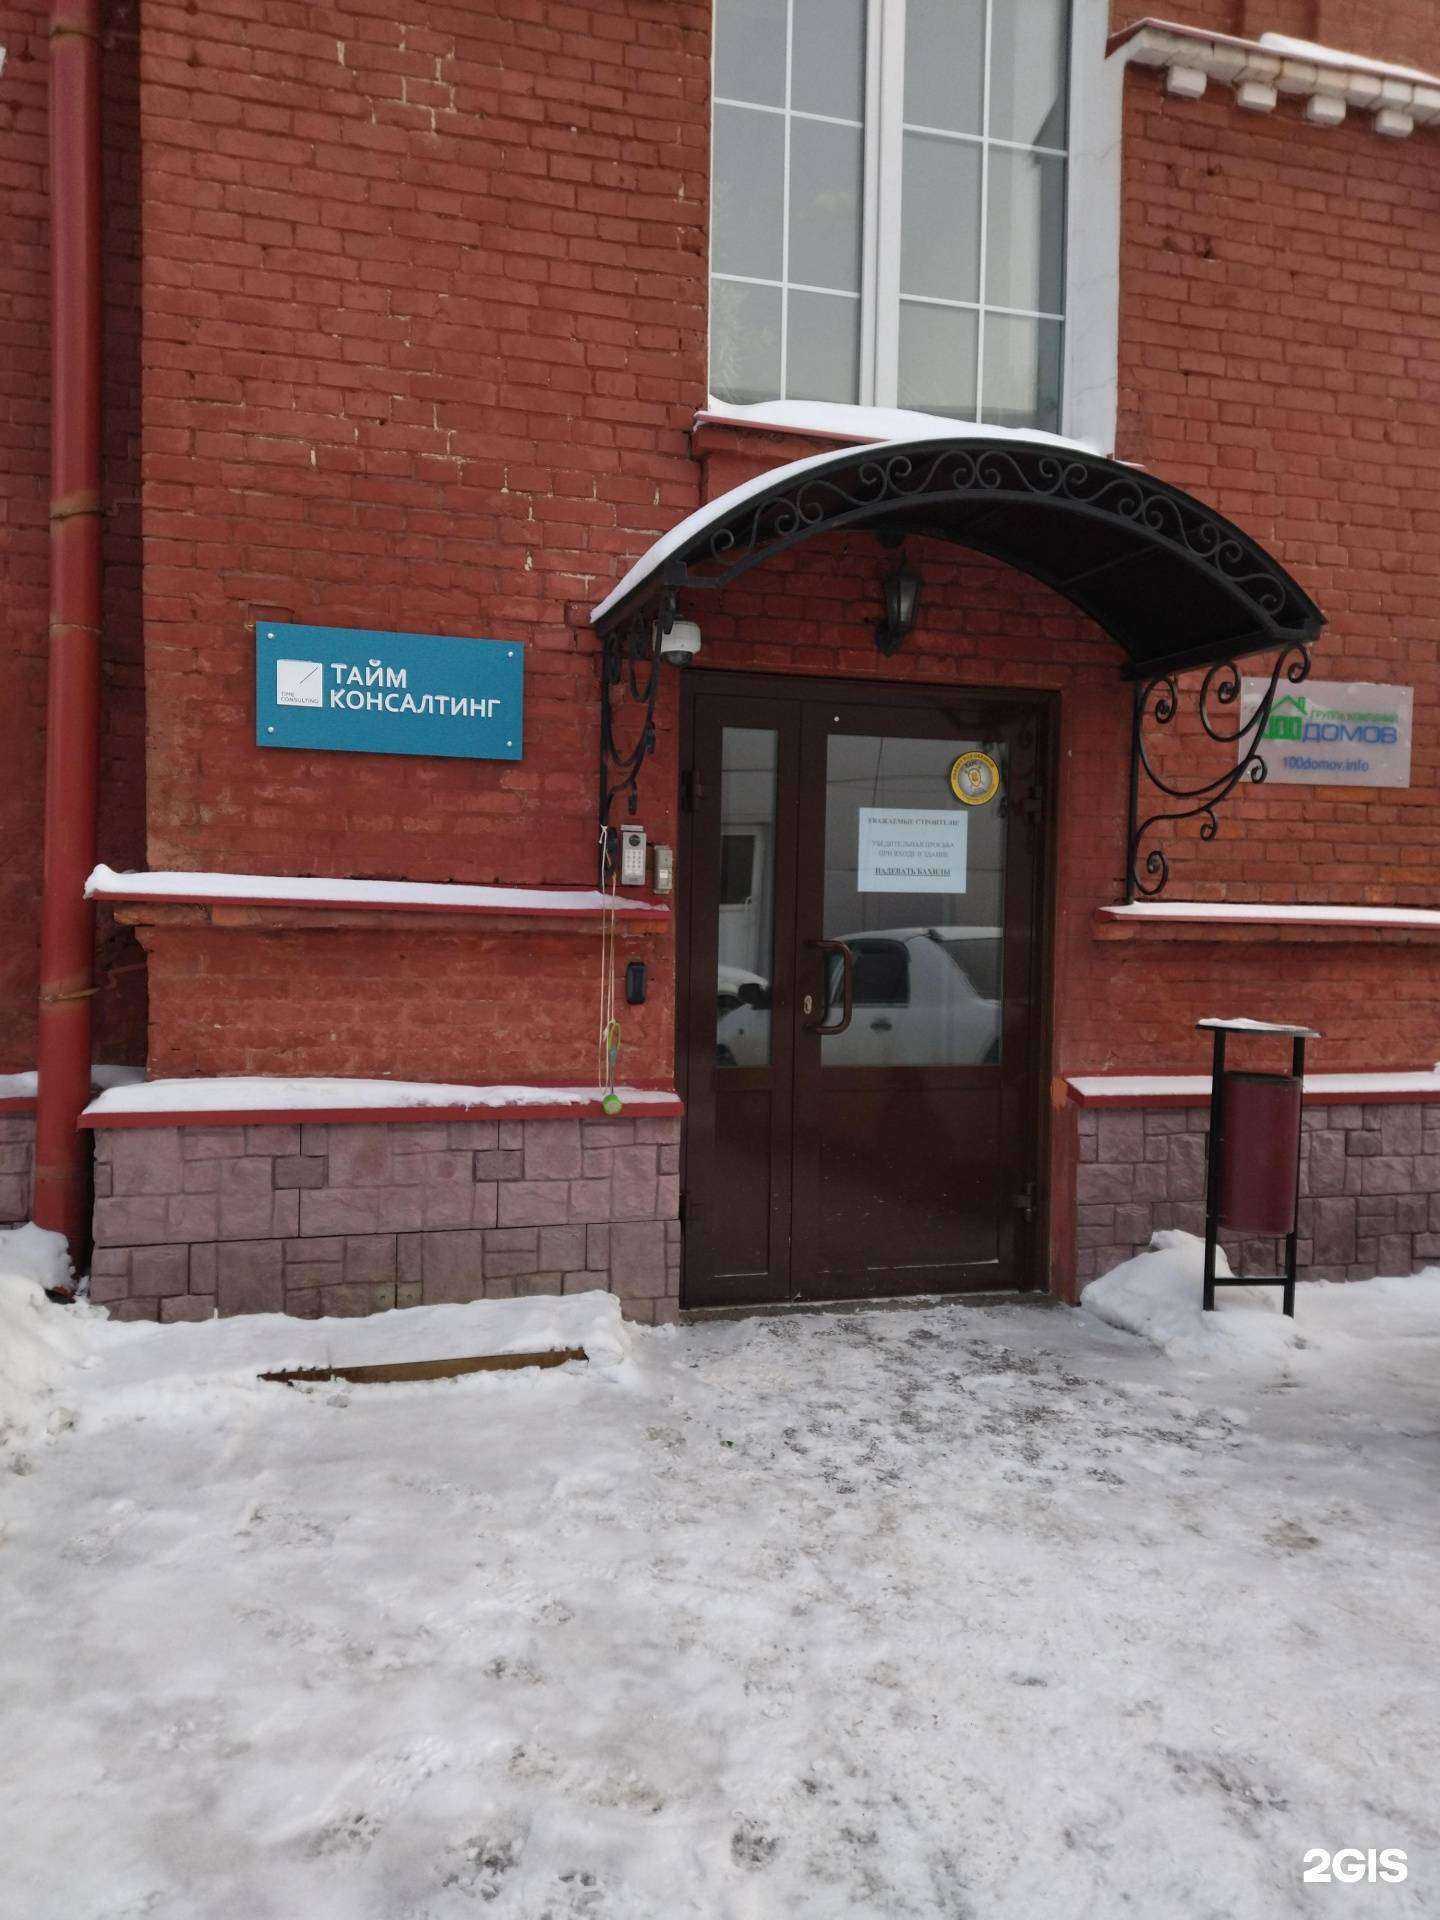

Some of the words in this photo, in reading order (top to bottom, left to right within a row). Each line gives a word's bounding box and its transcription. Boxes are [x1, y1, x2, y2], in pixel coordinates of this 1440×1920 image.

[330, 659, 407, 689] ТАЙМ
[330, 689, 501, 718] КОНСАЛТИНГ
[1302, 722, 1397, 744] ДОМОВ
[1283, 756, 1369, 772] 100domov.info
